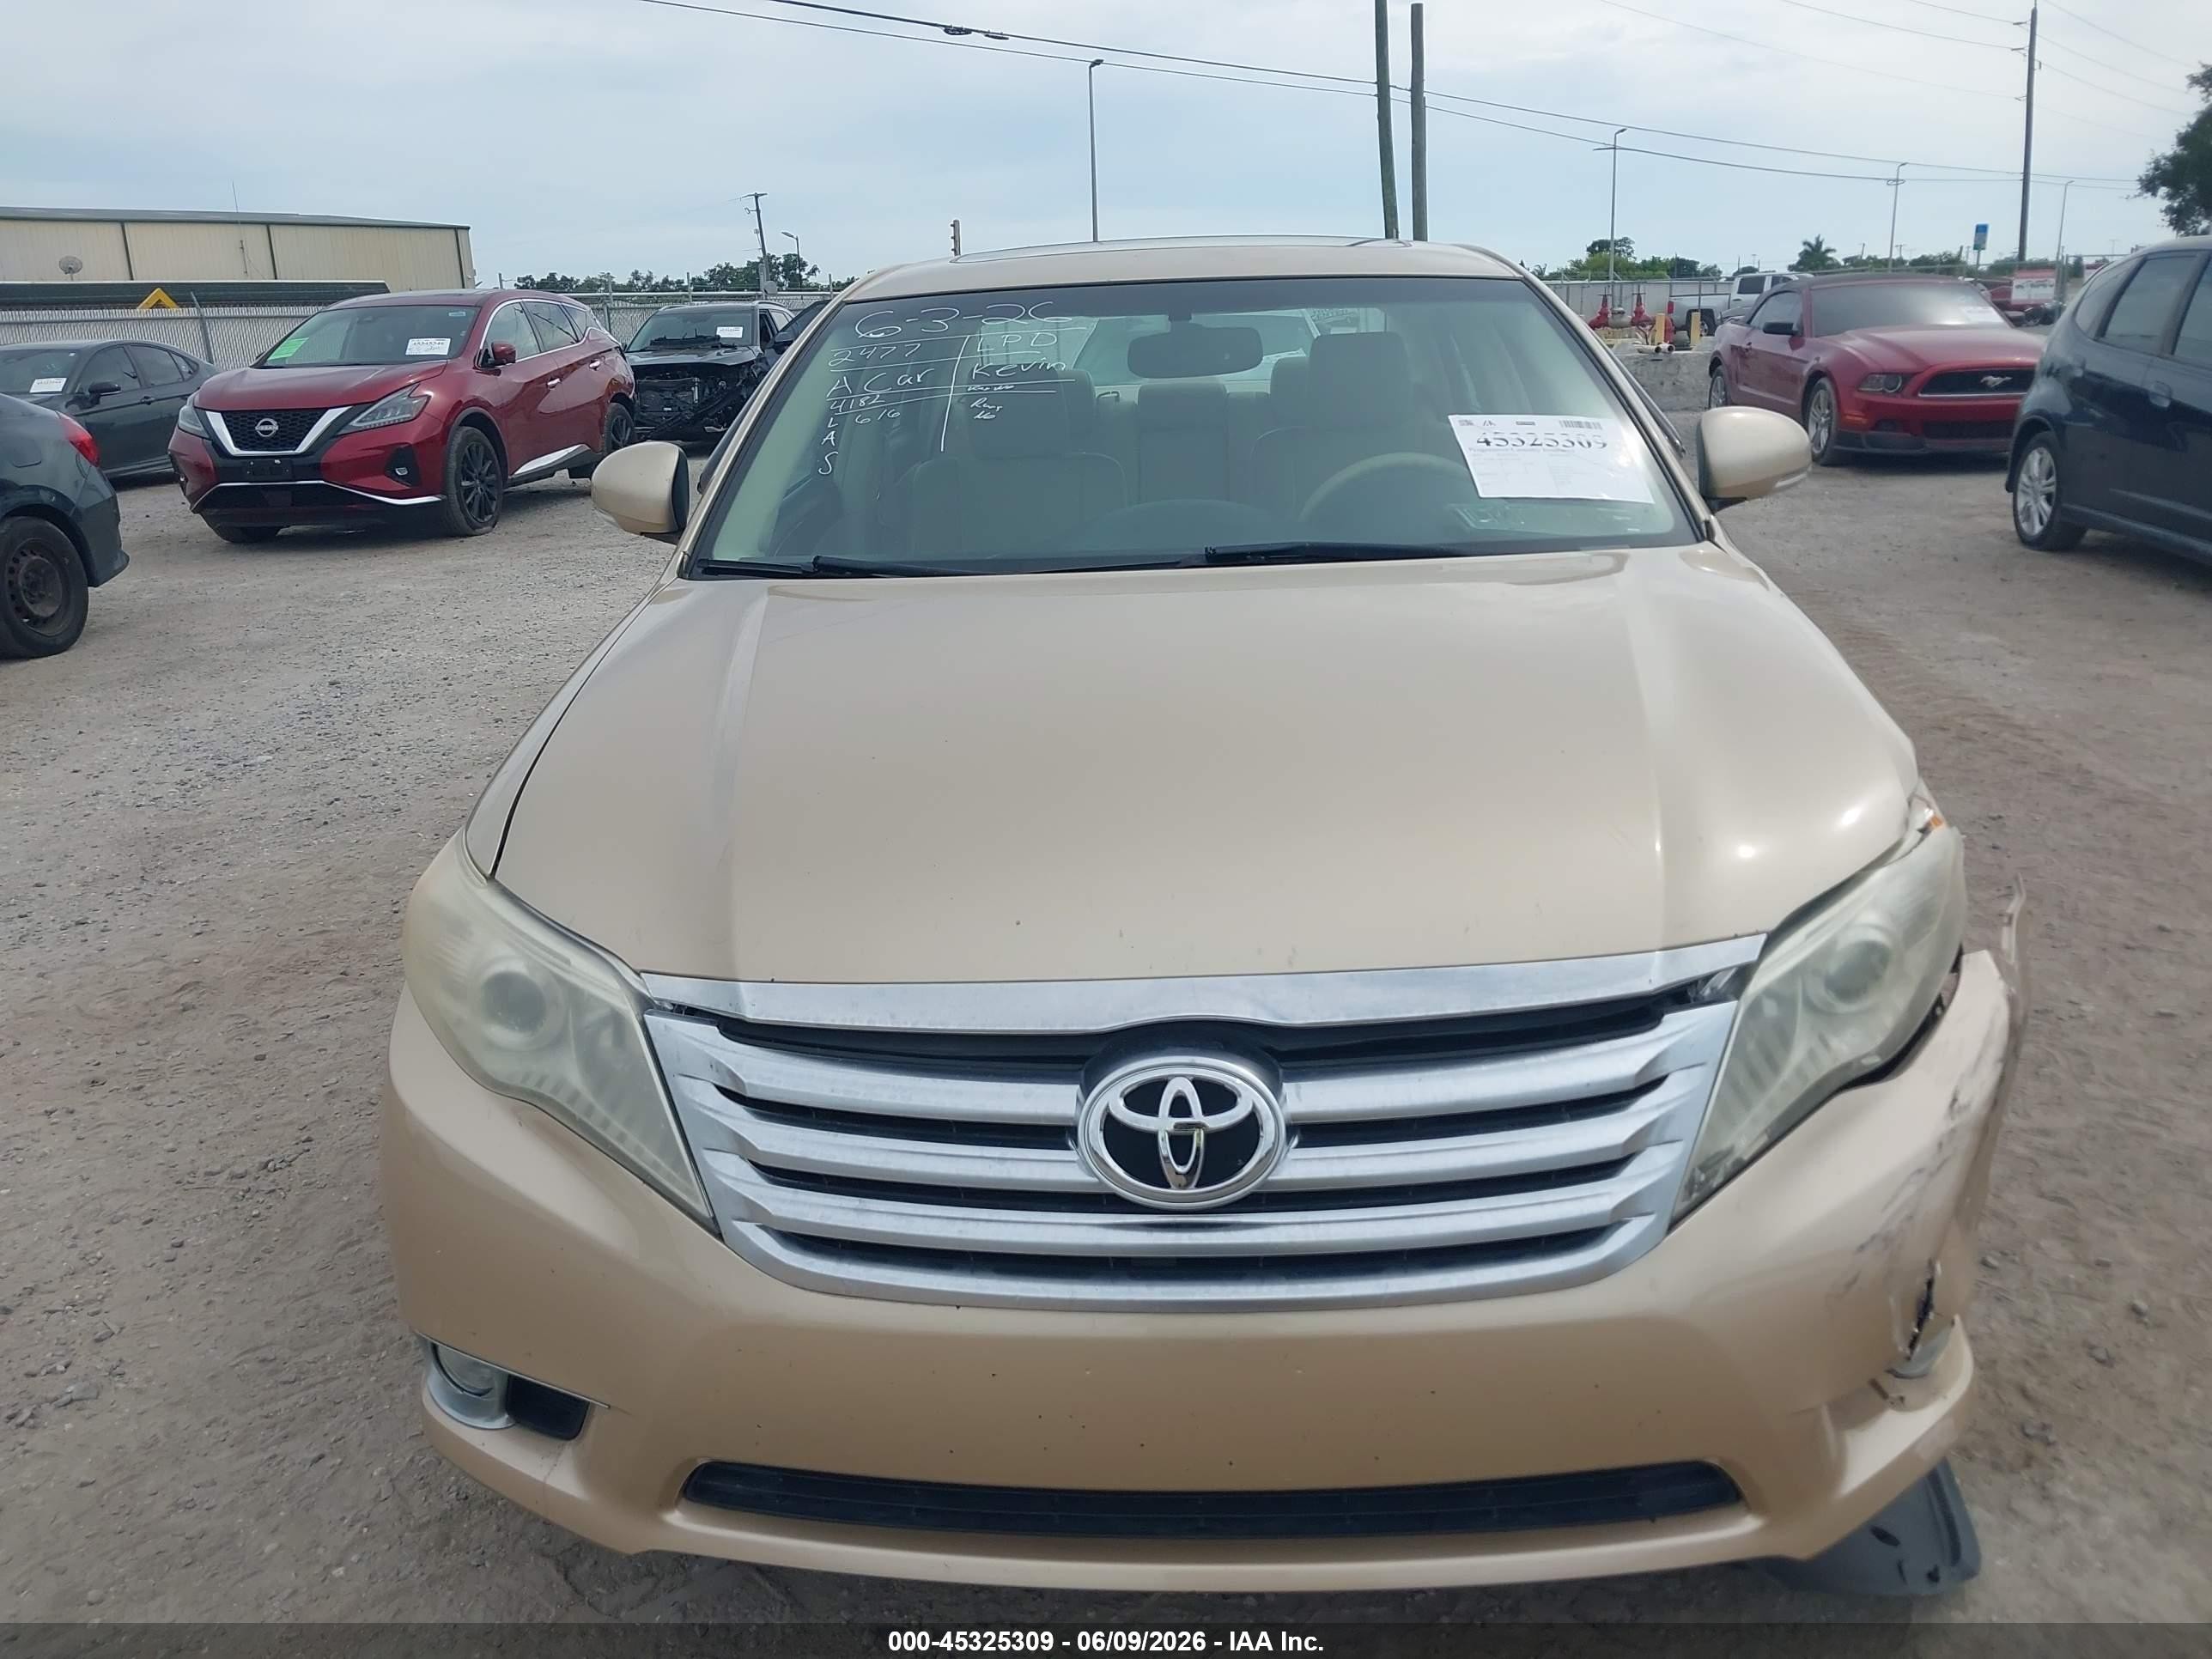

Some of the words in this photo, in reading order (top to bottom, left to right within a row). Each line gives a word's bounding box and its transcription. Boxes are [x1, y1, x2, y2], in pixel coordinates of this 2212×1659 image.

[855, 301, 1073, 338] 6-3-26
[828, 343, 921, 367] 2477
[971, 357, 1066, 380] Kevin
[1476, 432, 1608, 450] 45325309
